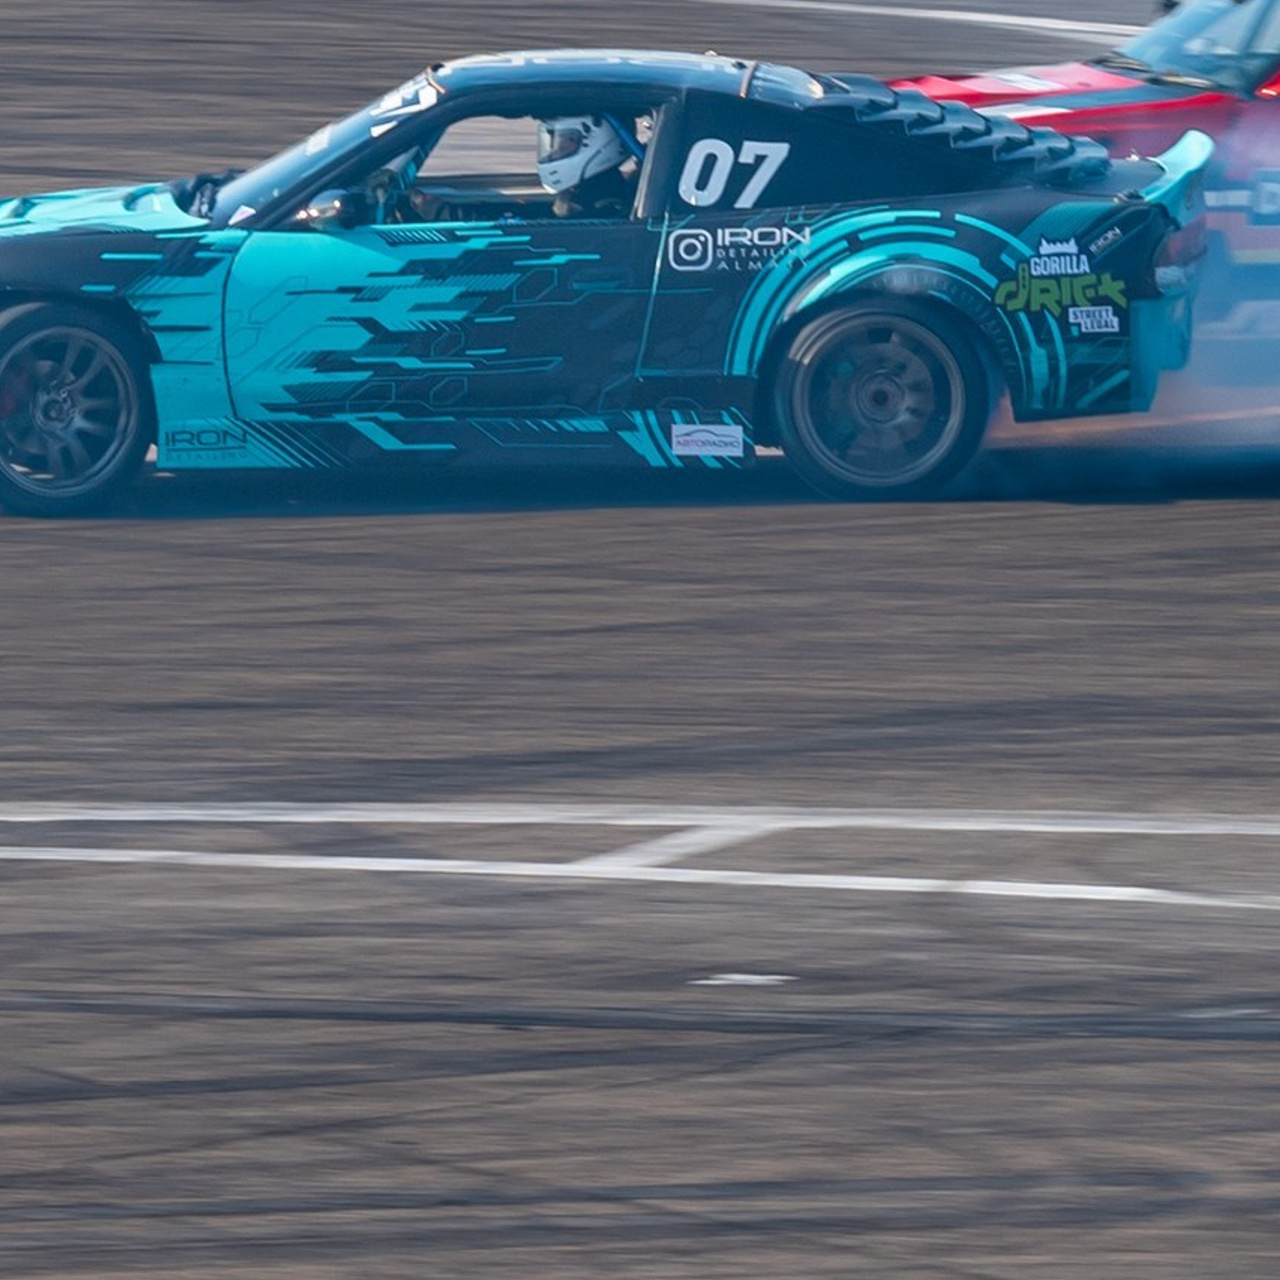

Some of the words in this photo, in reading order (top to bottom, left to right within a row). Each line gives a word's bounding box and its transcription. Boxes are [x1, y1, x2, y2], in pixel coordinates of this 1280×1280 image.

[678, 138, 791, 209] 07
[716, 227, 811, 246] IRON
[1030, 254, 1091, 276] GORILLA
[1071, 308, 1114, 321] STREET
[165, 429, 247, 447] IRON
